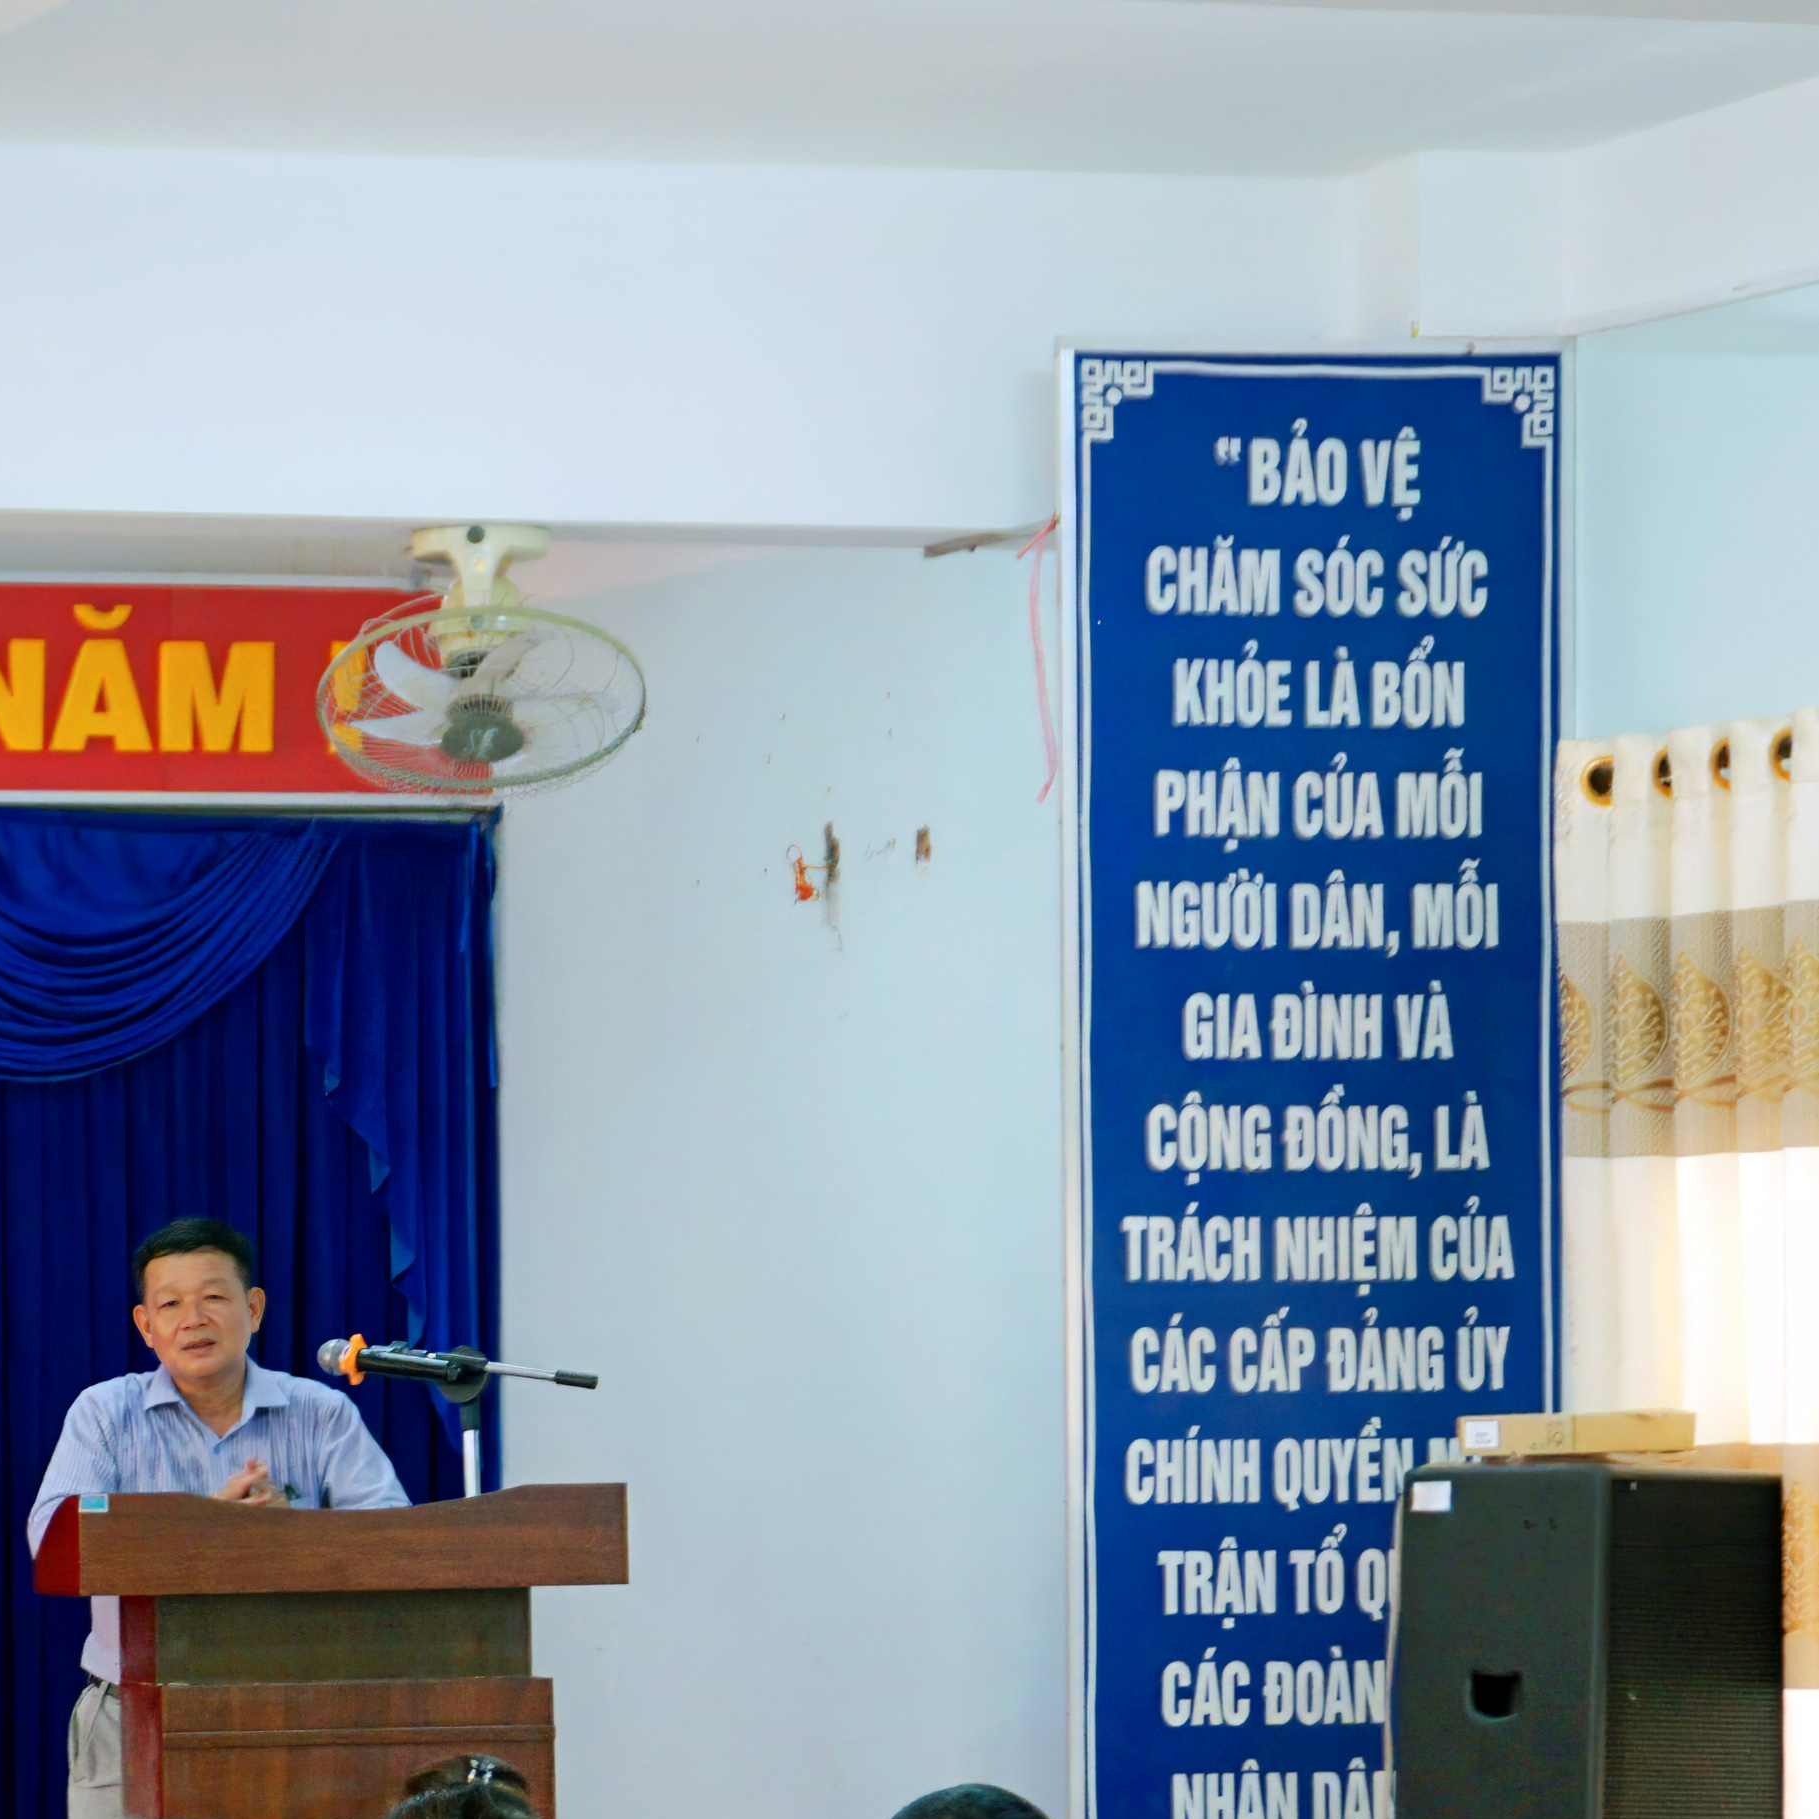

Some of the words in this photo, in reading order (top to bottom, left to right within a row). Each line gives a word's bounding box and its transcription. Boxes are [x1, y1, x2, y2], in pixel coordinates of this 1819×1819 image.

[1361, 426, 1421, 521] VỆ
[1146, 535, 1281, 616] CHĂM
[1294, 535, 1384, 617] SÓC
[1397, 536, 1488, 617] SỨC
[1174, 639, 1292, 727] KHỎE
[1305, 646, 1361, 727] LÀ
[1372, 635, 1465, 728] BỔN
[1155, 757, 1280, 852] PHẬN
[1293, 752, 1384, 839] CỦA
[1396, 747, 1483, 839] MỖI
[1136, 868, 1277, 949] NGƯỜI
[1290, 869, 1400, 958] DÂN,
[1412, 858, 1499, 949] MỖI
[1183, 992, 1262, 1060] GIA
[1269, 980, 1382, 1060] ĐÌNH
[1396, 980, 1454, 1060] VÀ
[1146, 1090, 1272, 1186] CỘNG
[1281, 1083, 1423, 1180] ĐỒNG,
[1435, 1090, 1490, 1170] LÀ
[1120, 1201, 1261, 1282] TRÁCH
[1274, 1202, 1418, 1297] NHIỆM
[1430, 1195, 1515, 1281] CỦA
[1130, 1312, 1217, 1394] CÁC
[1227, 1305, 1316, 1394] CẤP
[1326, 1307, 1445, 1392] ĐẢNG
[1457, 1306, 1511, 1392] ỦY
[1125, 1425, 1261, 1505] CHÍNH
[1273, 1416, 1414, 1512] QUYỀN
[1157, 1536, 1277, 1629] TRẬN
[1289, 1523, 1347, 1614] TỔ
[1161, 1646, 1251, 1727] CÁC
[1263, 1645, 1386, 1726] ĐOÀN
